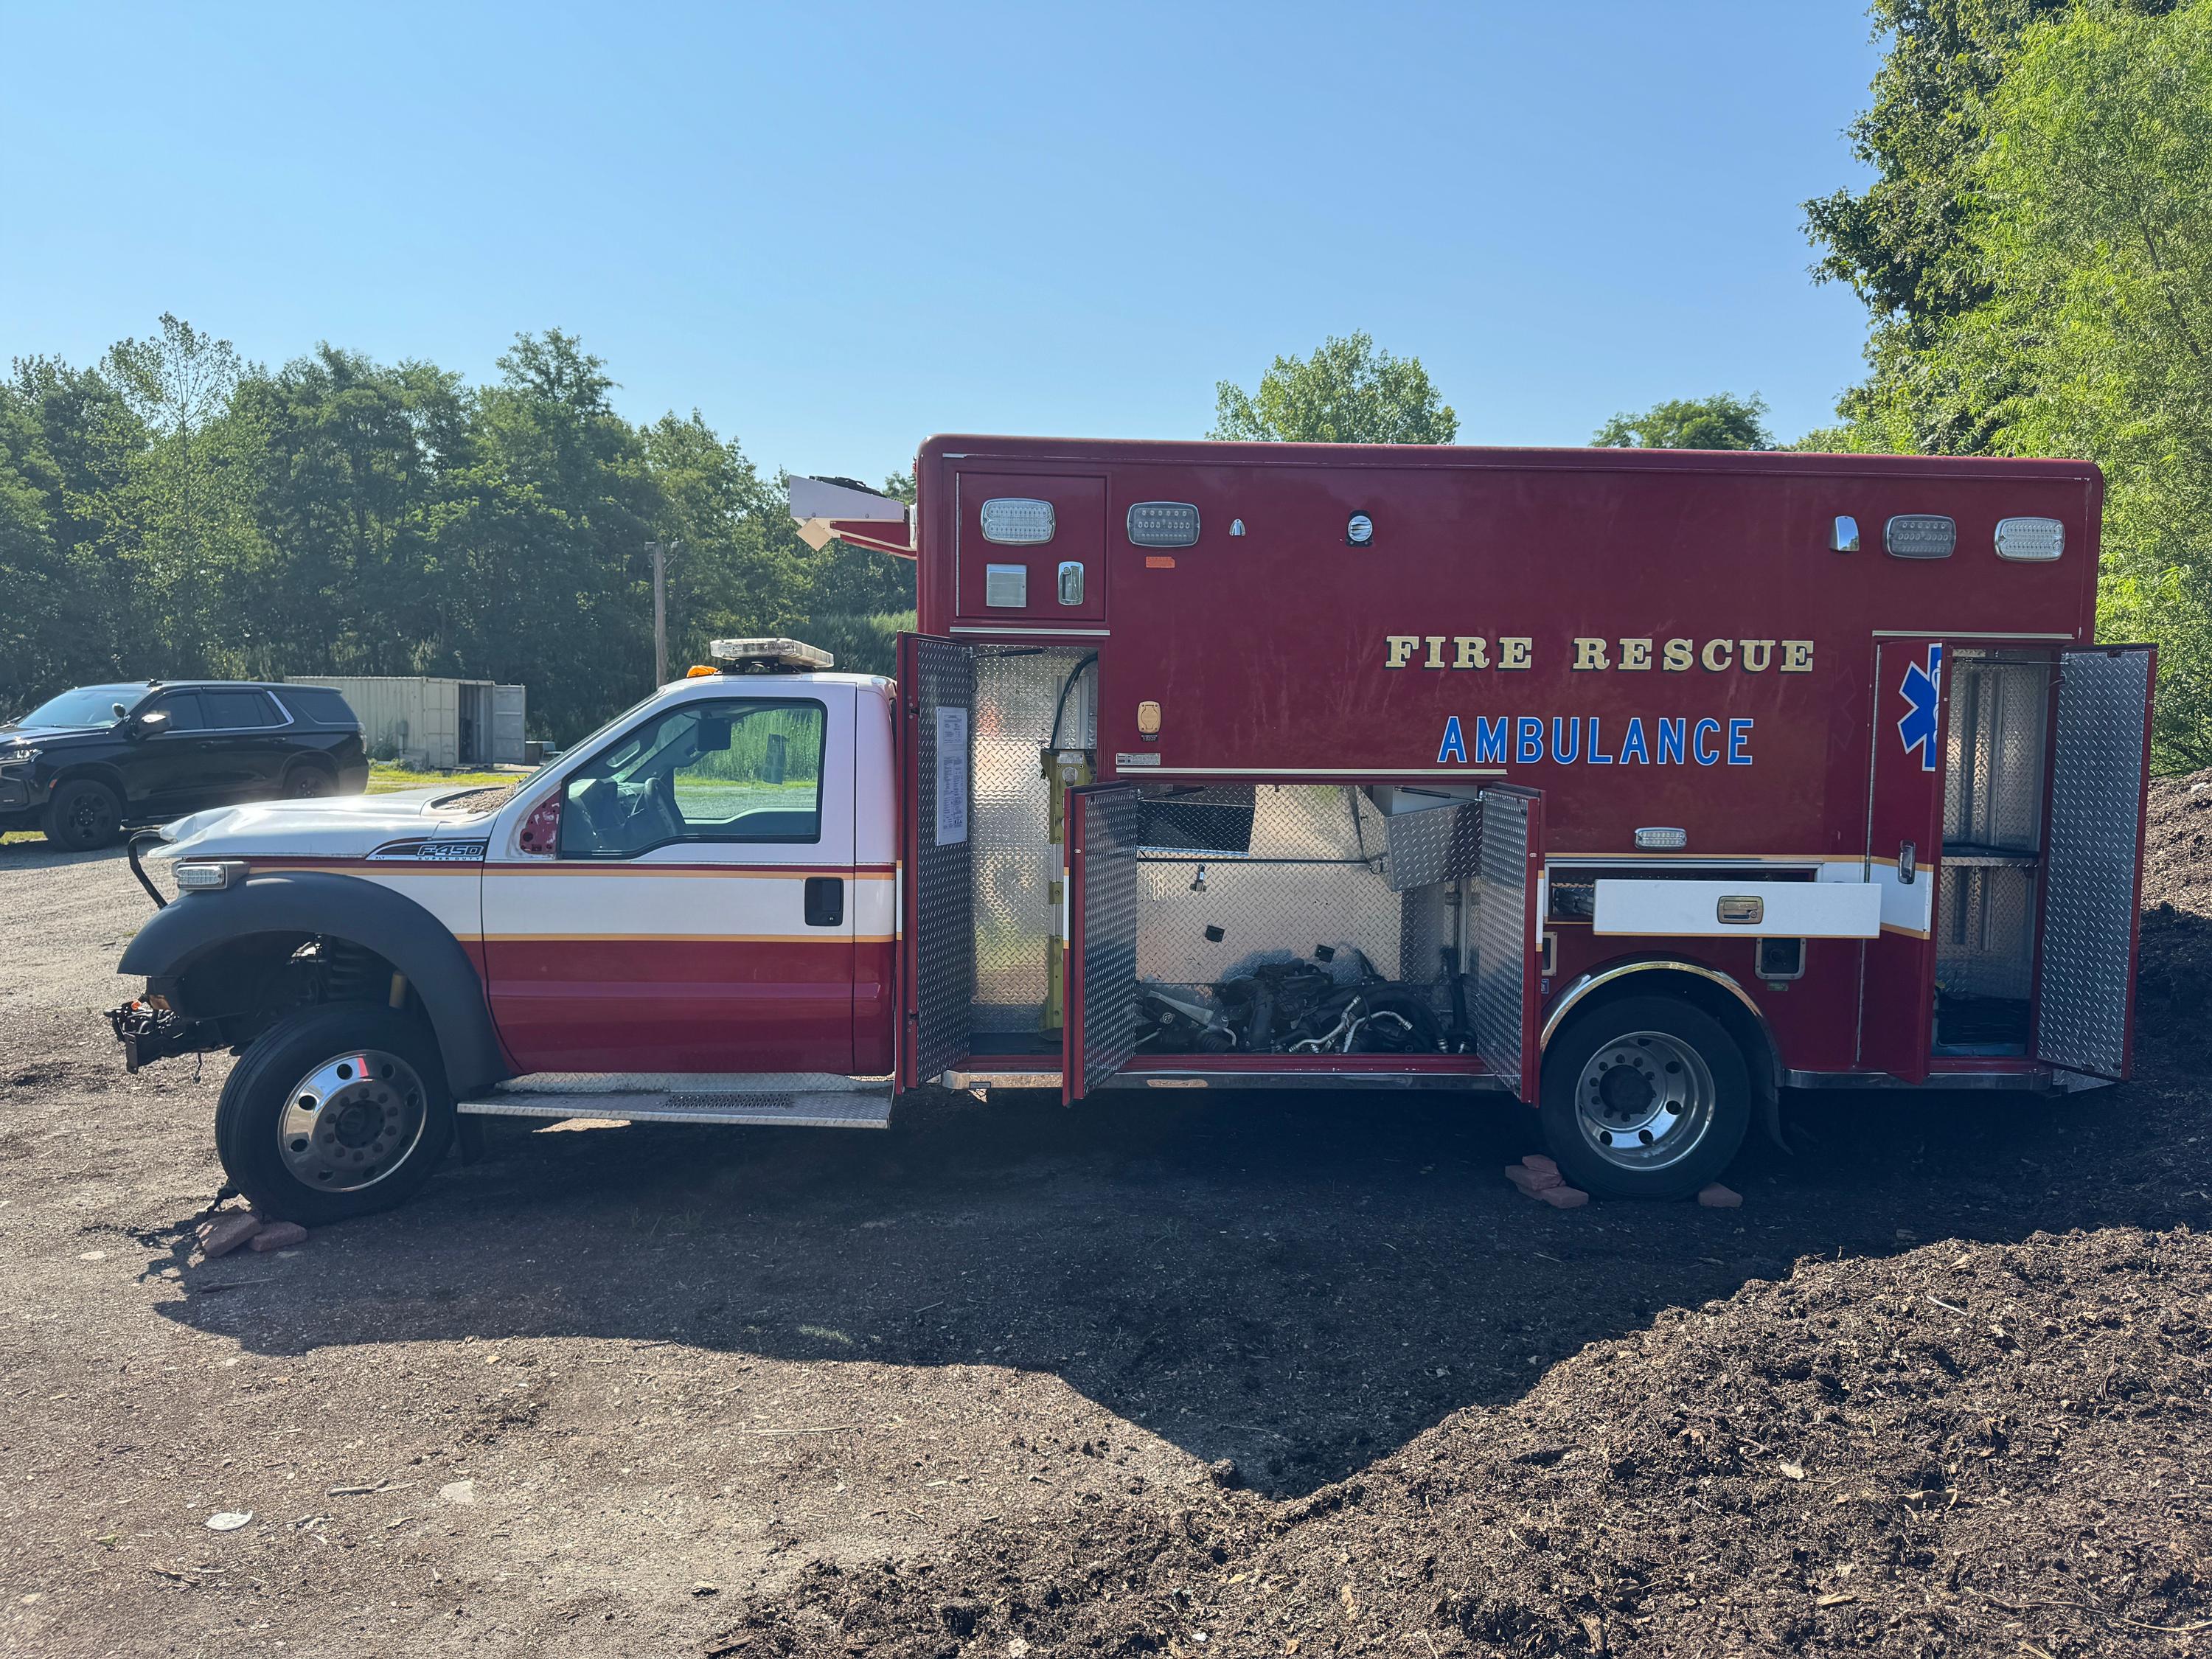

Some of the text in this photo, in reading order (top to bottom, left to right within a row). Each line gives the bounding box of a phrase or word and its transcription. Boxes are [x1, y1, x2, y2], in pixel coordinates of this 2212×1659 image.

[1385, 636, 1815, 672] FIRE RESCUE
[1437, 715, 1754, 765] AMBULANCE
[417, 844, 484, 856] F-450
